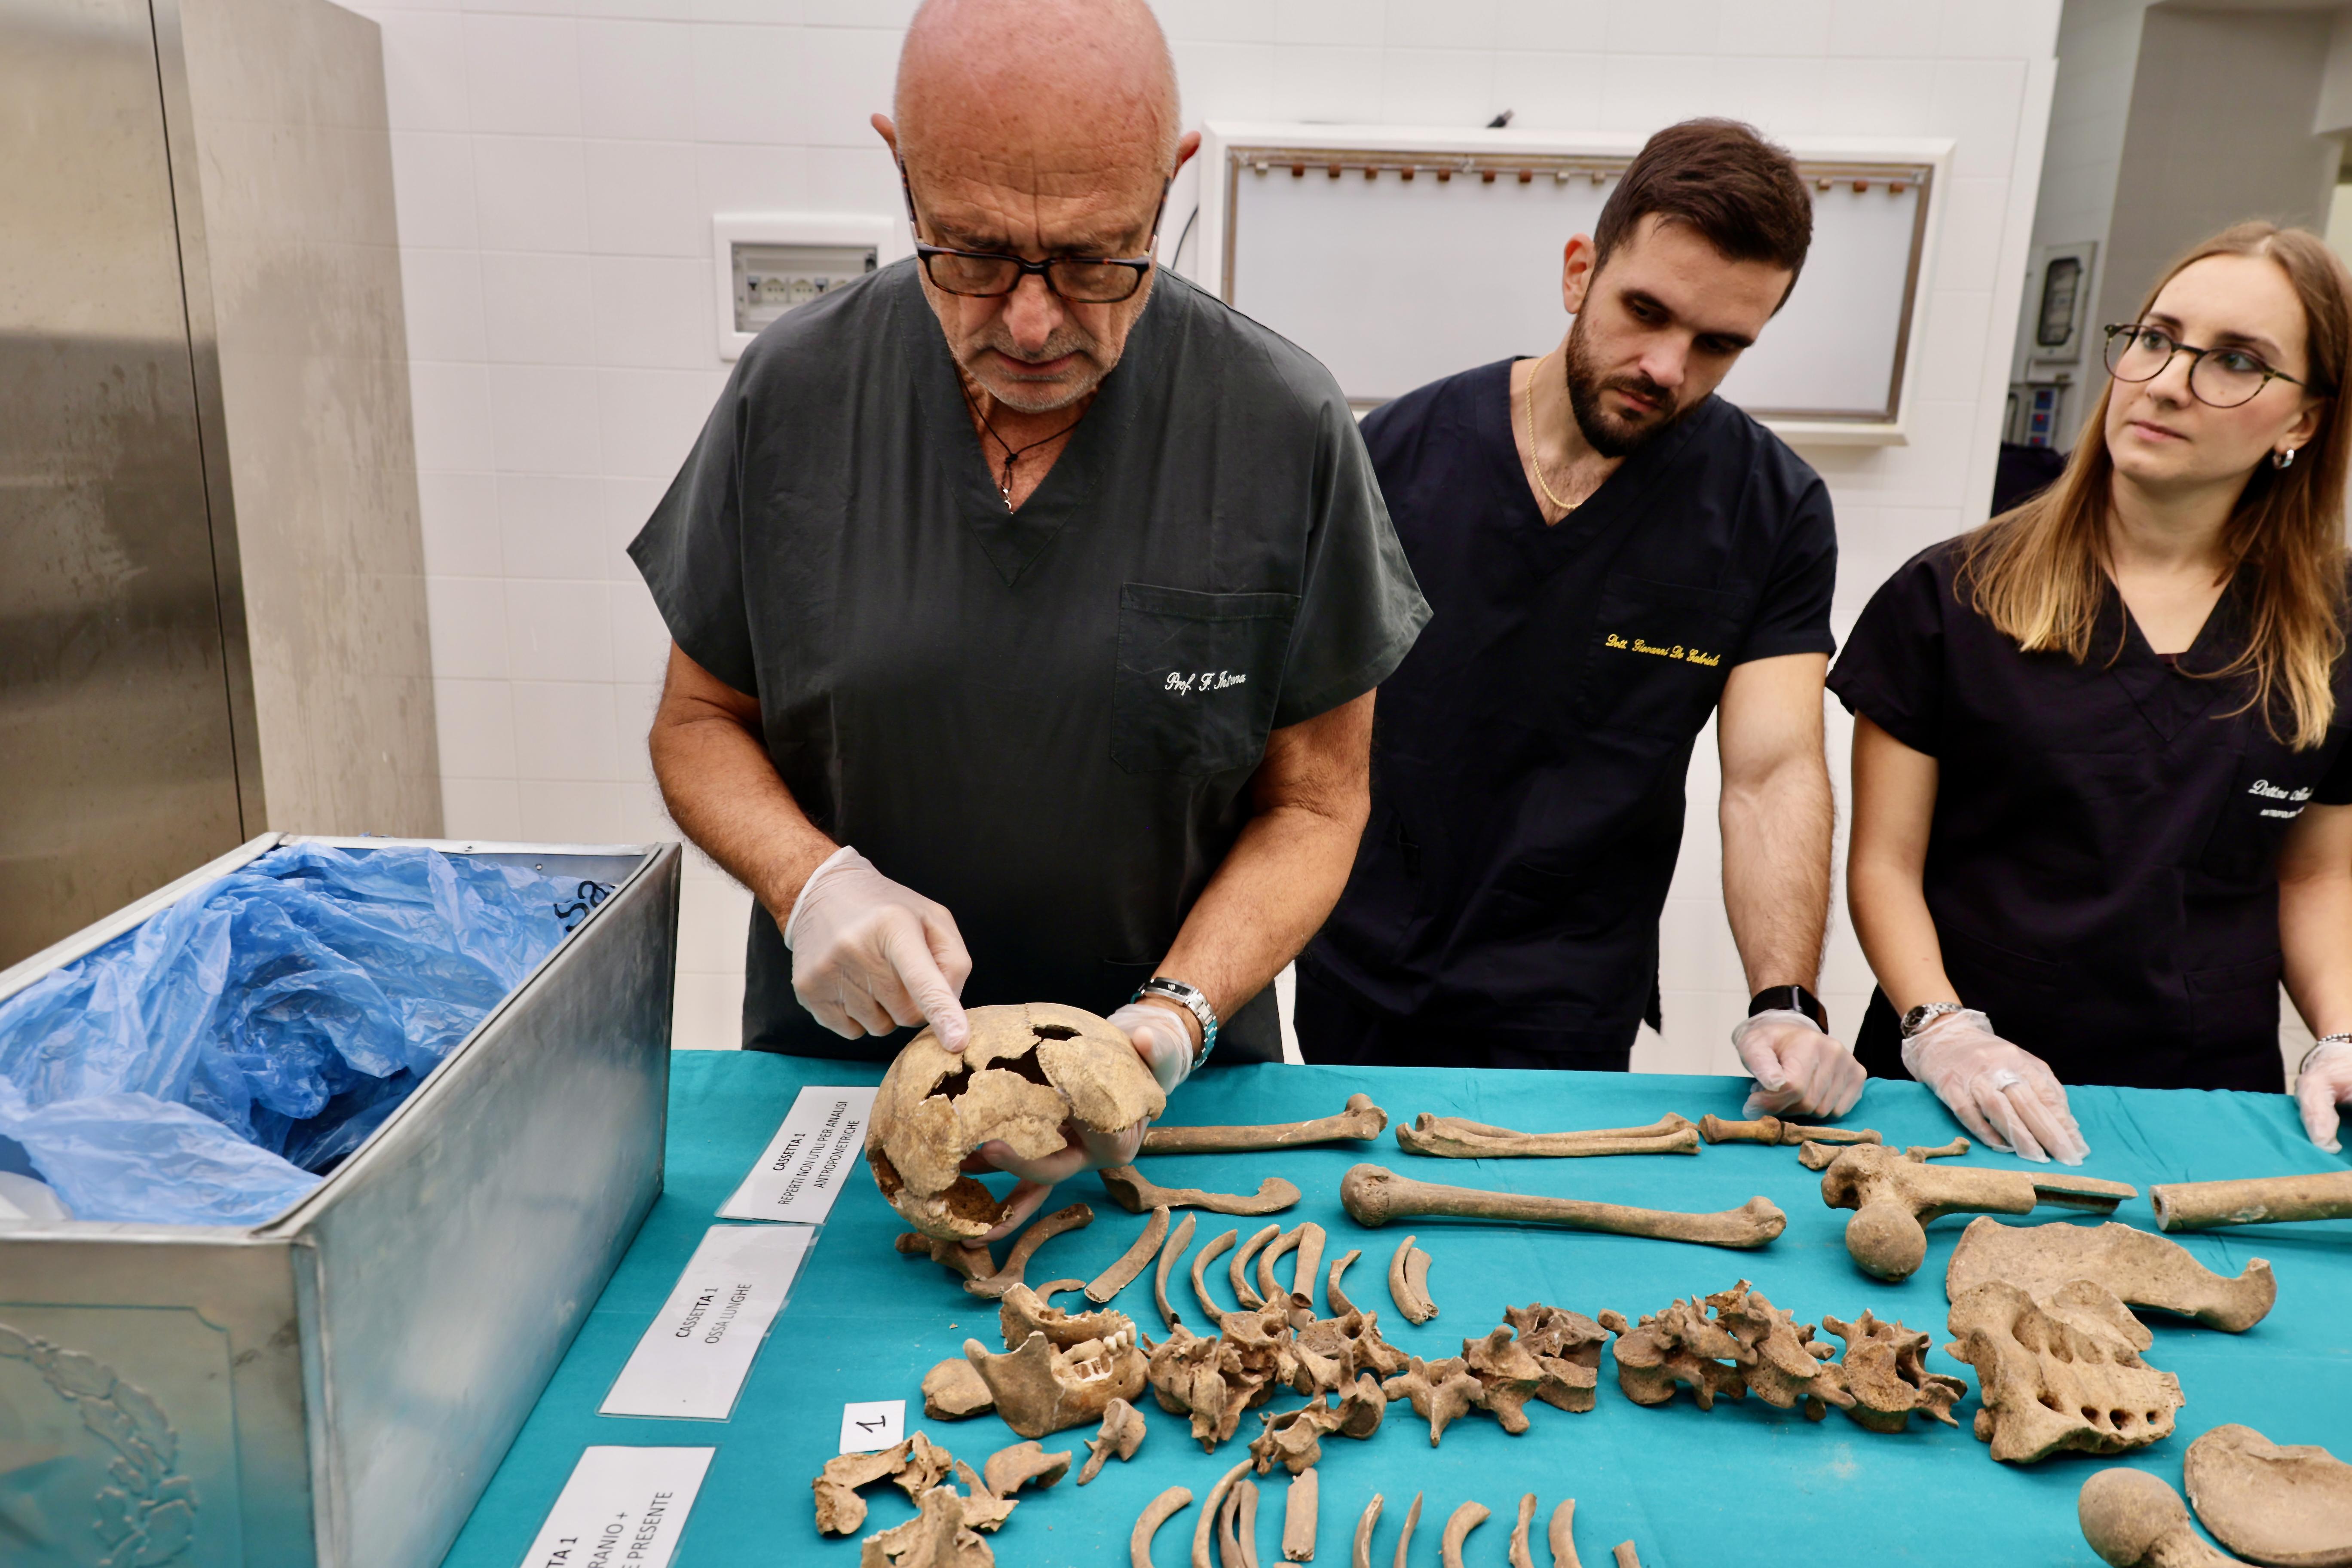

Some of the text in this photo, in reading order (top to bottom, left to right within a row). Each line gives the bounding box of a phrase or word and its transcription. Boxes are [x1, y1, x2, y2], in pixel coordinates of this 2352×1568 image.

[773, 1139, 802, 1170] CASSETTA
[778, 1102, 848, 1204] REPERTI NON UTILI PER ANALISI
[814, 1121, 860, 1188] ANTROPOMETRICHE
[676, 1295, 714, 1337] CASSETTA
[705, 1284, 752, 1344] OSSA LUNGHE
[856, 1415, 885, 1433] 1
[627, 1492, 673, 1559] PRESENTE
